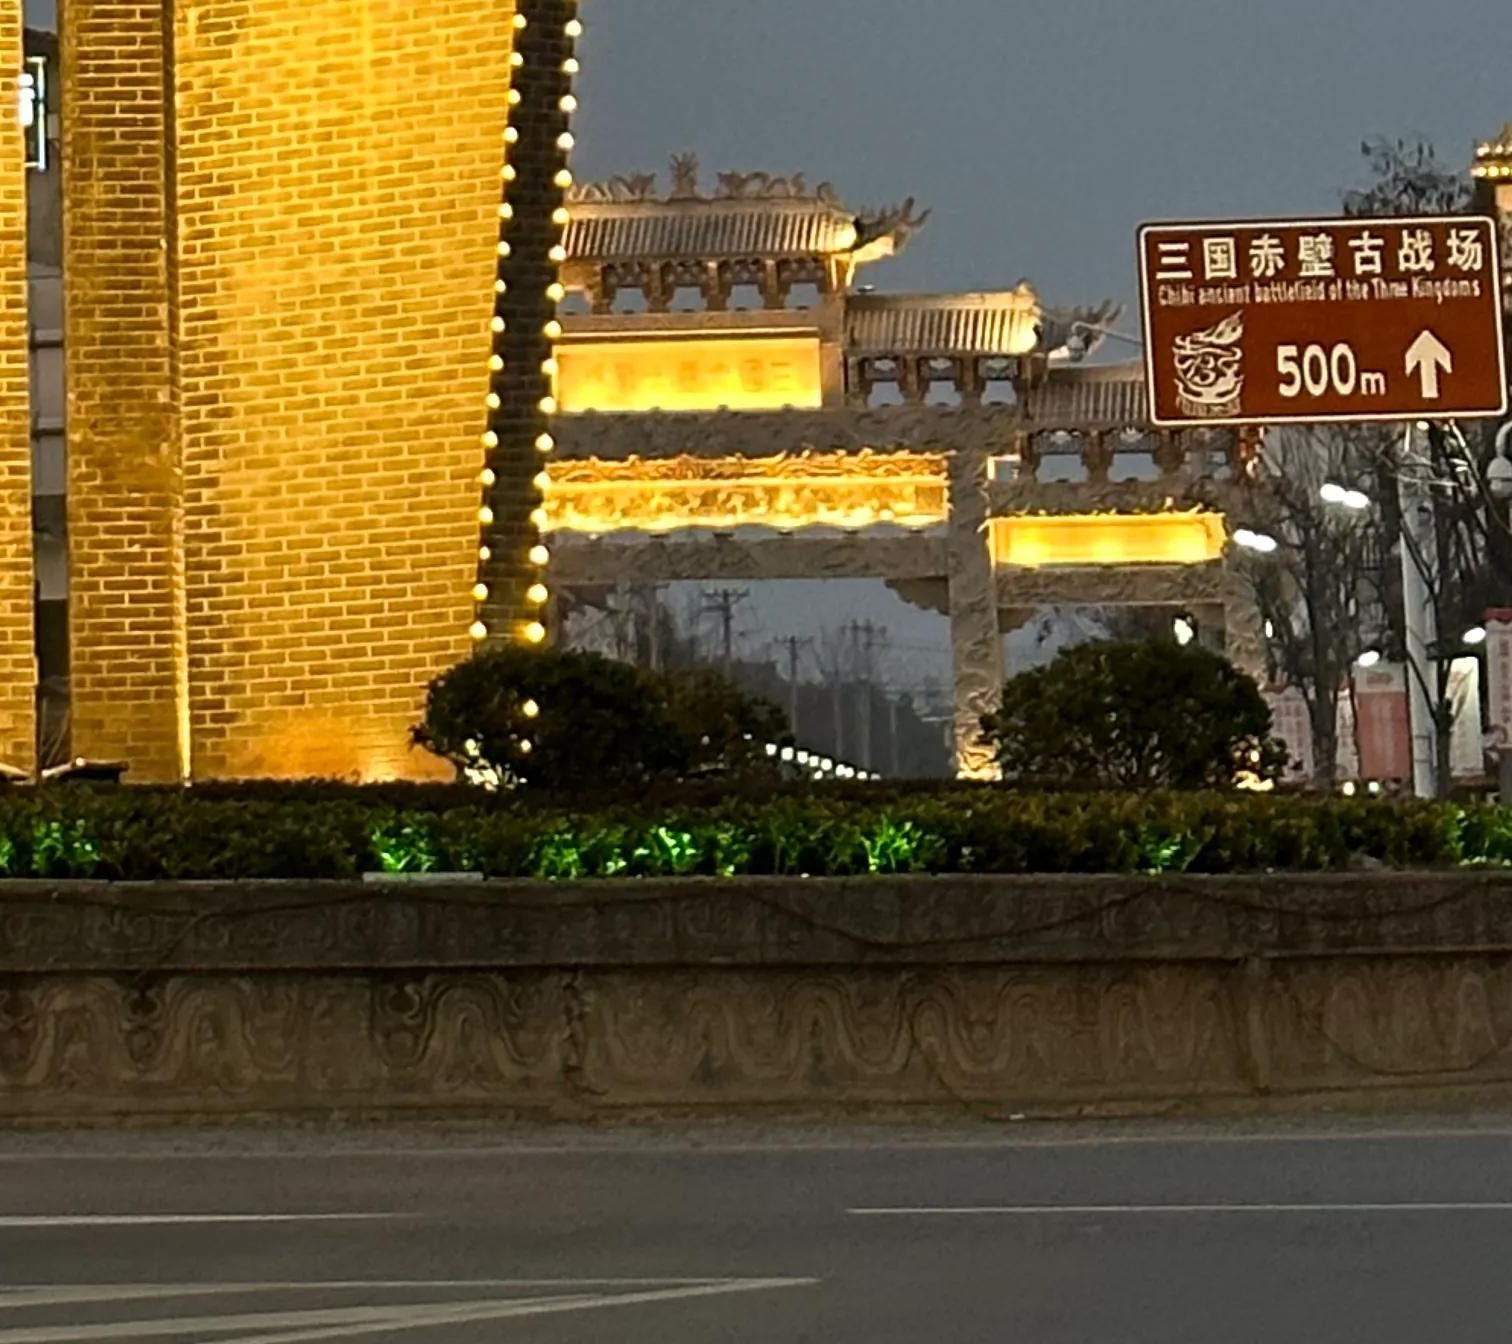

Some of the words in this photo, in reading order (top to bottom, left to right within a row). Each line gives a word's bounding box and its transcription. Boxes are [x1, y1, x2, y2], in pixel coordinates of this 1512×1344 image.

[1156, 228, 1484, 280] 三国赤壁古战场
[1159, 283, 1195, 306] Chibi
[1198, 282, 1250, 305] ancient
[1254, 279, 1325, 303] battlefield
[1328, 278, 1342, 301] of
[1346, 279, 1369, 301] the
[1371, 277, 1409, 299] Three
[1411, 275, 1481, 305] Kingdoms
[1276, 342, 1386, 398] 500m
